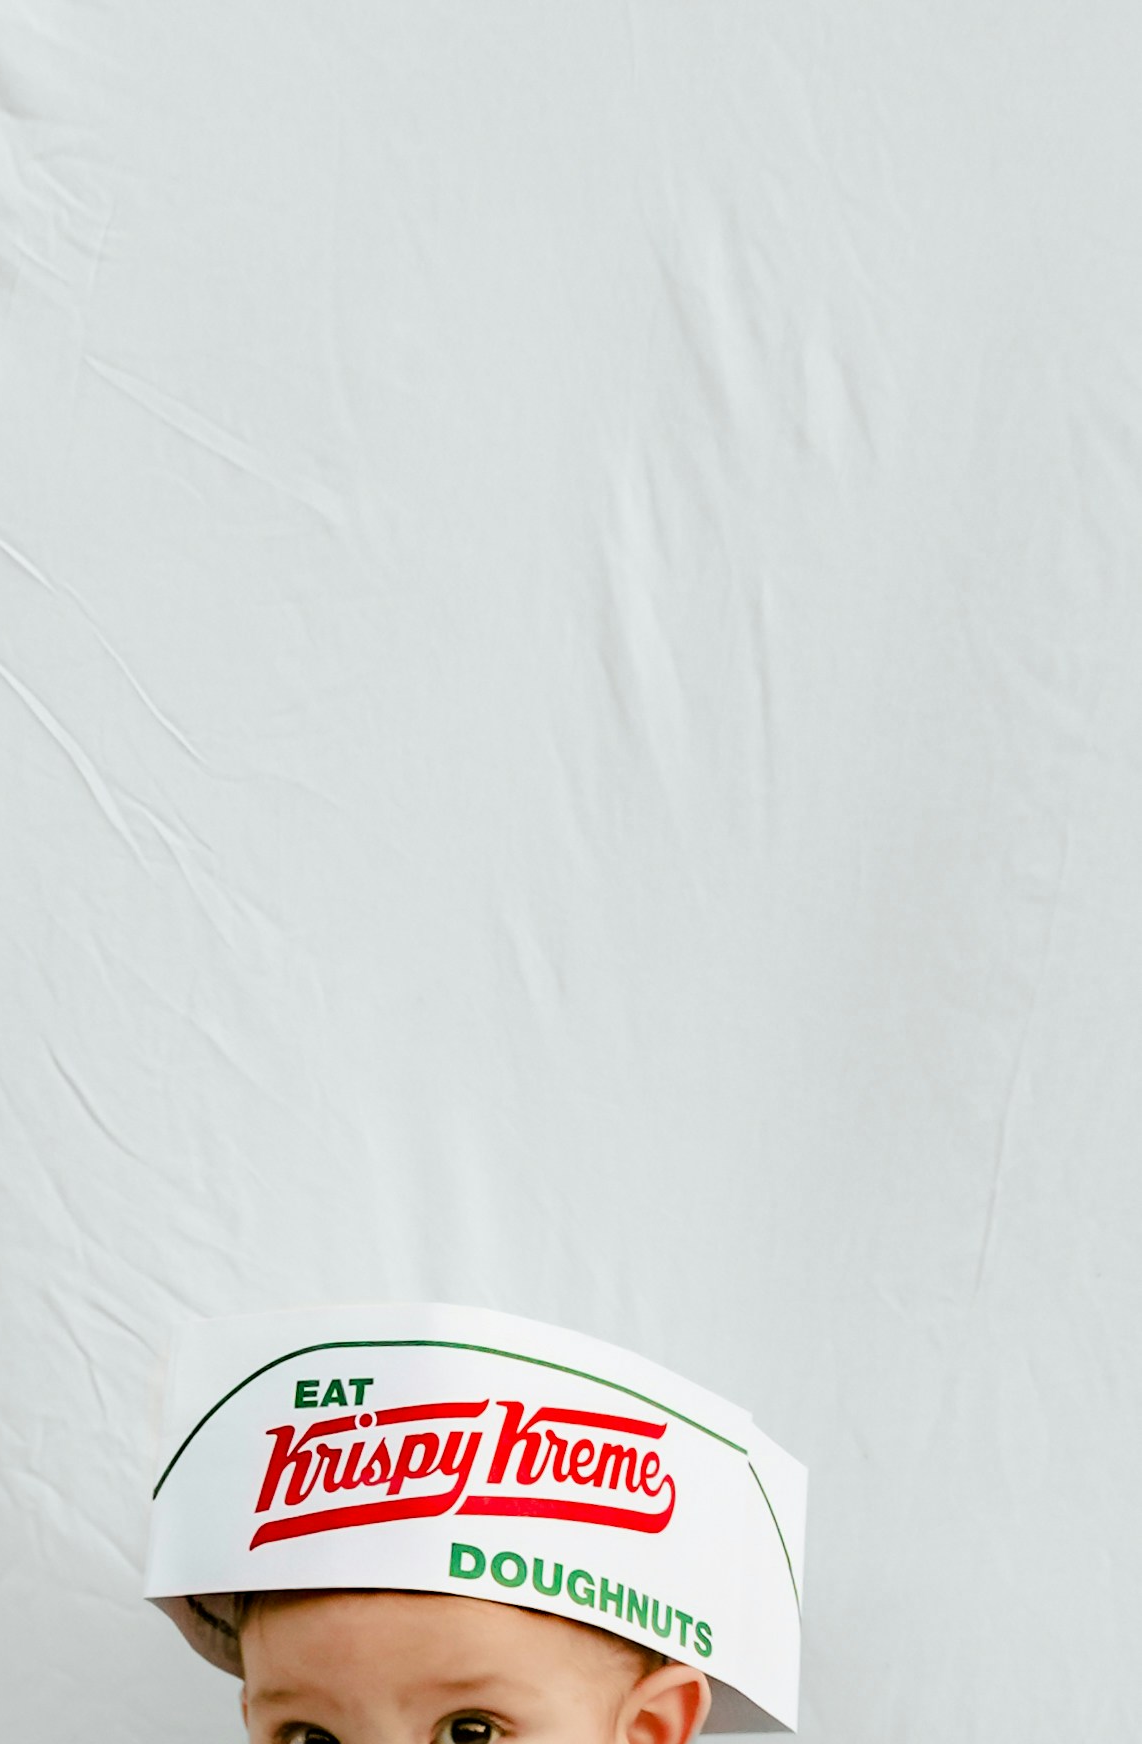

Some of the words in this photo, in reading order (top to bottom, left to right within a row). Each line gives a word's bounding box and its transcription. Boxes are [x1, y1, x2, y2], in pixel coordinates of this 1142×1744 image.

[294, 1377, 374, 1409] EAT
[249, 1399, 489, 1550] Krispy
[454, 1400, 675, 1534] Kreme
[448, 1542, 714, 1658] DOUGHNUTS
